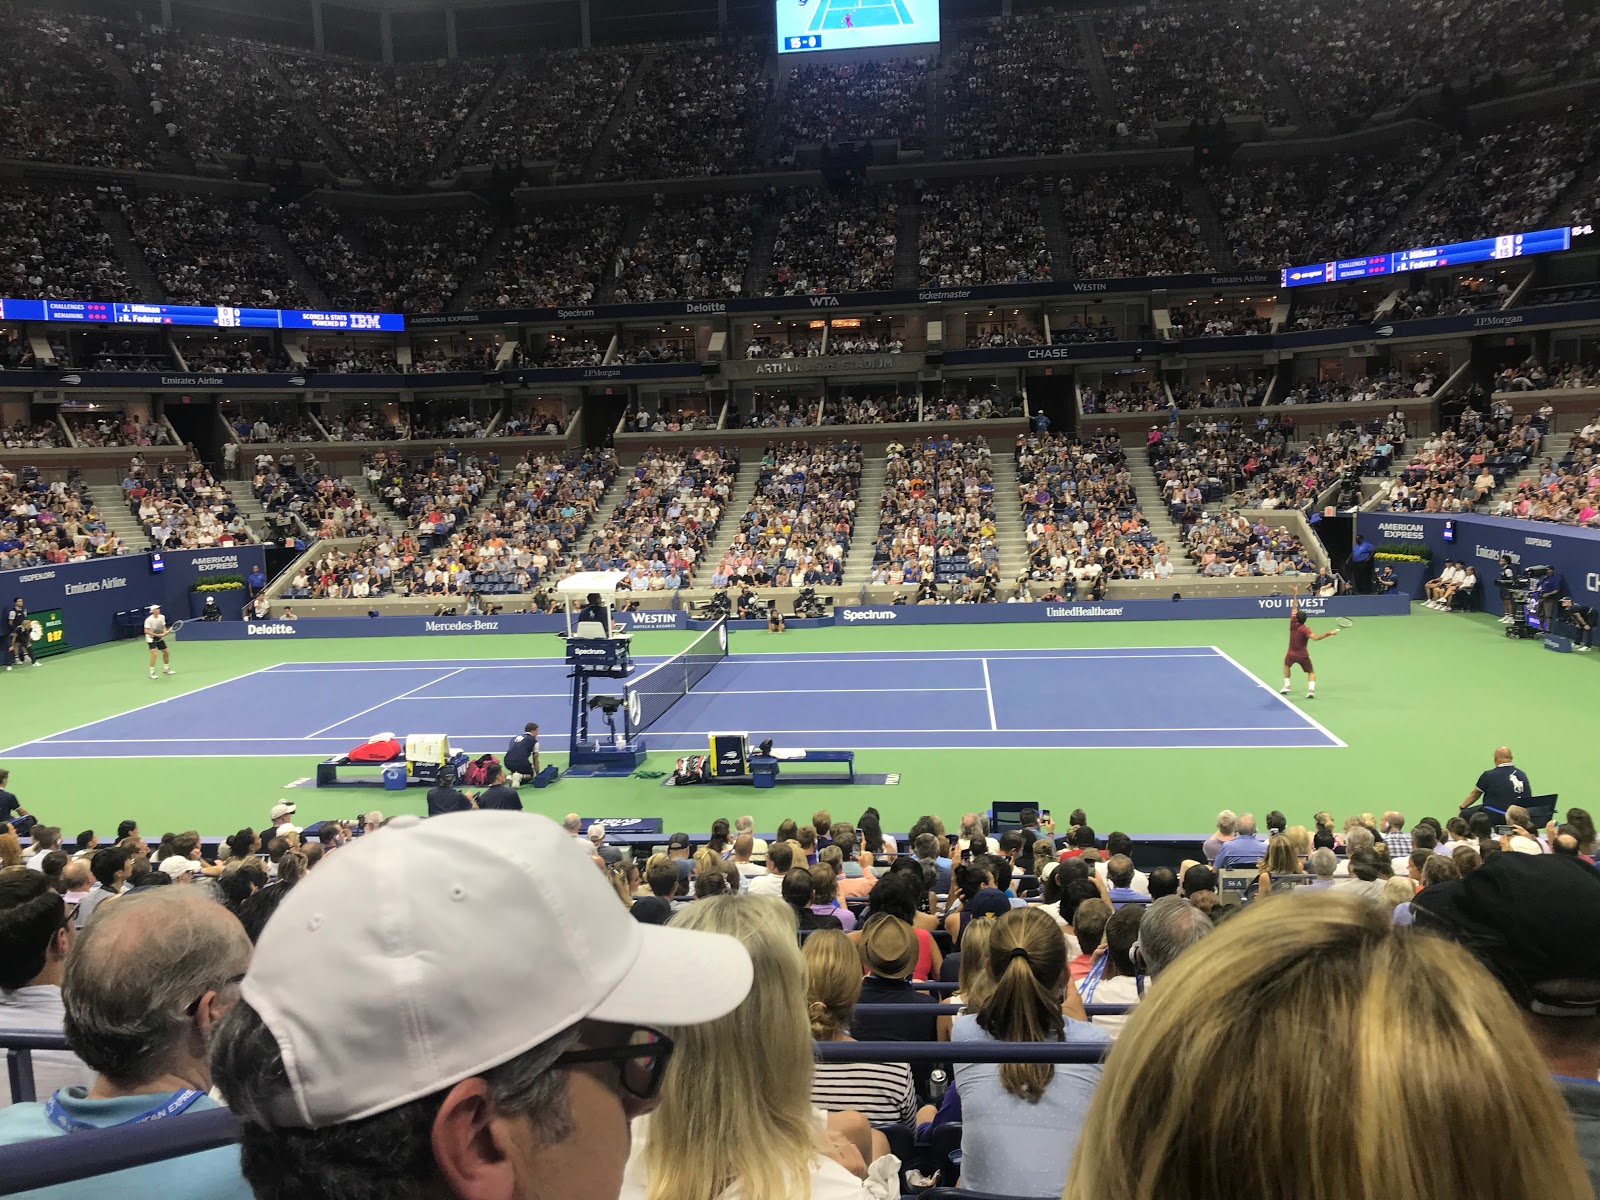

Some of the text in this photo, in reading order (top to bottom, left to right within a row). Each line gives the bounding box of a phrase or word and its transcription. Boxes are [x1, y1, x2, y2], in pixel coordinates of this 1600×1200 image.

[1515, 235, 1523, 244] 0
[1410, 259, 1438, 270] Federer
[1500, 247, 1510, 257] 15
[1515, 246, 1523, 255] 2
[1338, 260, 1367, 270] CHALLENGES
[1212, 274, 1268, 284] Emirates Airline
[1340, 269, 1365, 278] REMAINING
[918, 289, 971, 300] ticketmaster
[809, 296, 840, 307] WTA
[223, 308, 229, 316] 0
[233, 308, 241, 317] 0
[686, 302, 726, 313] Deloitte
[557, 308, 595, 319] Spectrum
[132, 314, 162, 323] Federer
[234, 318, 241, 326] 2
[350, 314, 381, 329] IBM
[410, 315, 479, 324] AMERICAN EXPRESS
[1473, 315, 1523, 327] J.P.Morgan
[1028, 348, 1068, 360] CHASE
[583, 369, 621, 378] J.P.Morgan
[756, 362, 802, 374] ARTHUR
[161, 376, 223, 385] Emirates Airline
[1378, 522, 1424, 532] AMERICAN
[1384, 530, 1424, 540] EXPRESS
[191, 555, 237, 566] AMERICAN
[198, 561, 239, 572] EXPRESS
[64, 576, 127, 595] Emirates Airline
[1258, 599, 1282, 609] YOU
[843, 609, 895, 622] Spectrum
[1046, 606, 1123, 617] UnitedHealthcare
[631, 612, 676, 624] WESTIN
[247, 624, 296, 635] Deloitte.
[425, 620, 499, 631] Mercedes-Benz
[574, 647, 606, 656] Spectrum
[167, 1088, 199, 1114] EXPRE
